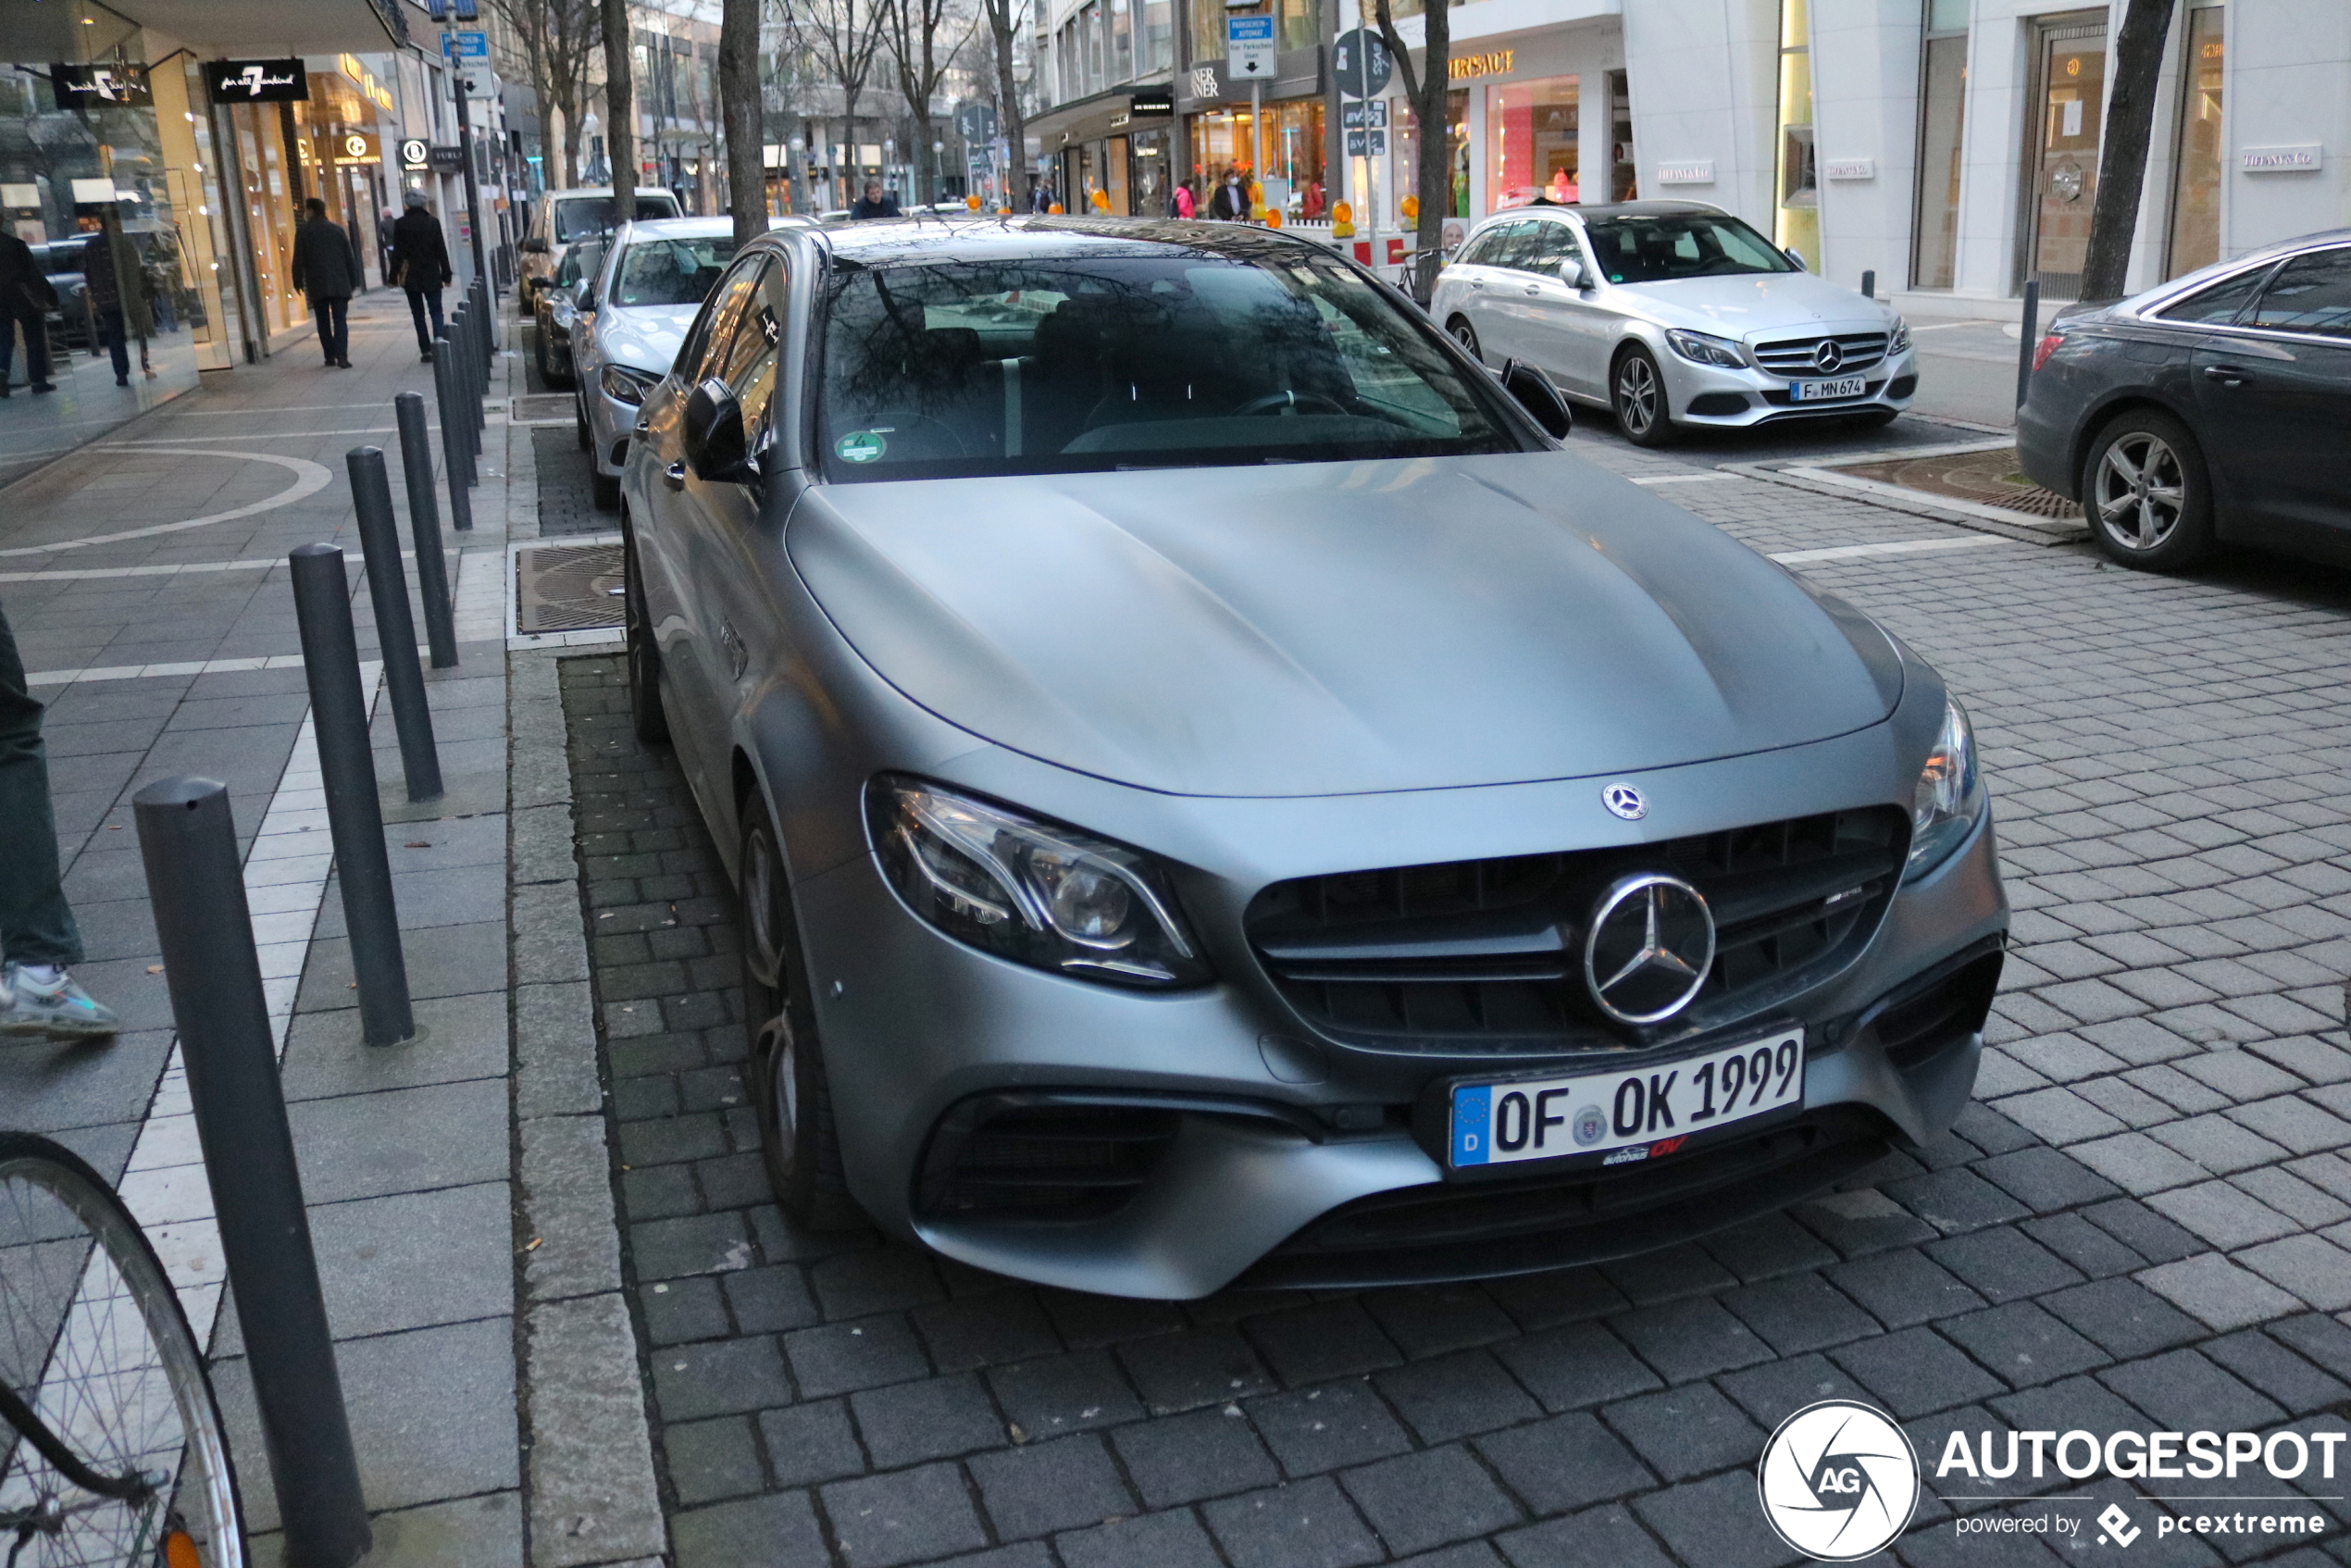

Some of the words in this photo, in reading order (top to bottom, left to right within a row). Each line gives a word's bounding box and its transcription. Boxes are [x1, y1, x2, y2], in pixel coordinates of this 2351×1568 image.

[1804, 384, 1812, 397] F
[1821, 382, 1837, 396] MN
[1839, 380, 1860, 394] 674
[1496, 1088, 1569, 1152] OF
[1612, 1070, 1679, 1139] OK
[1690, 1039, 1798, 1123] 1999
[1464, 1135, 1478, 1151] D
